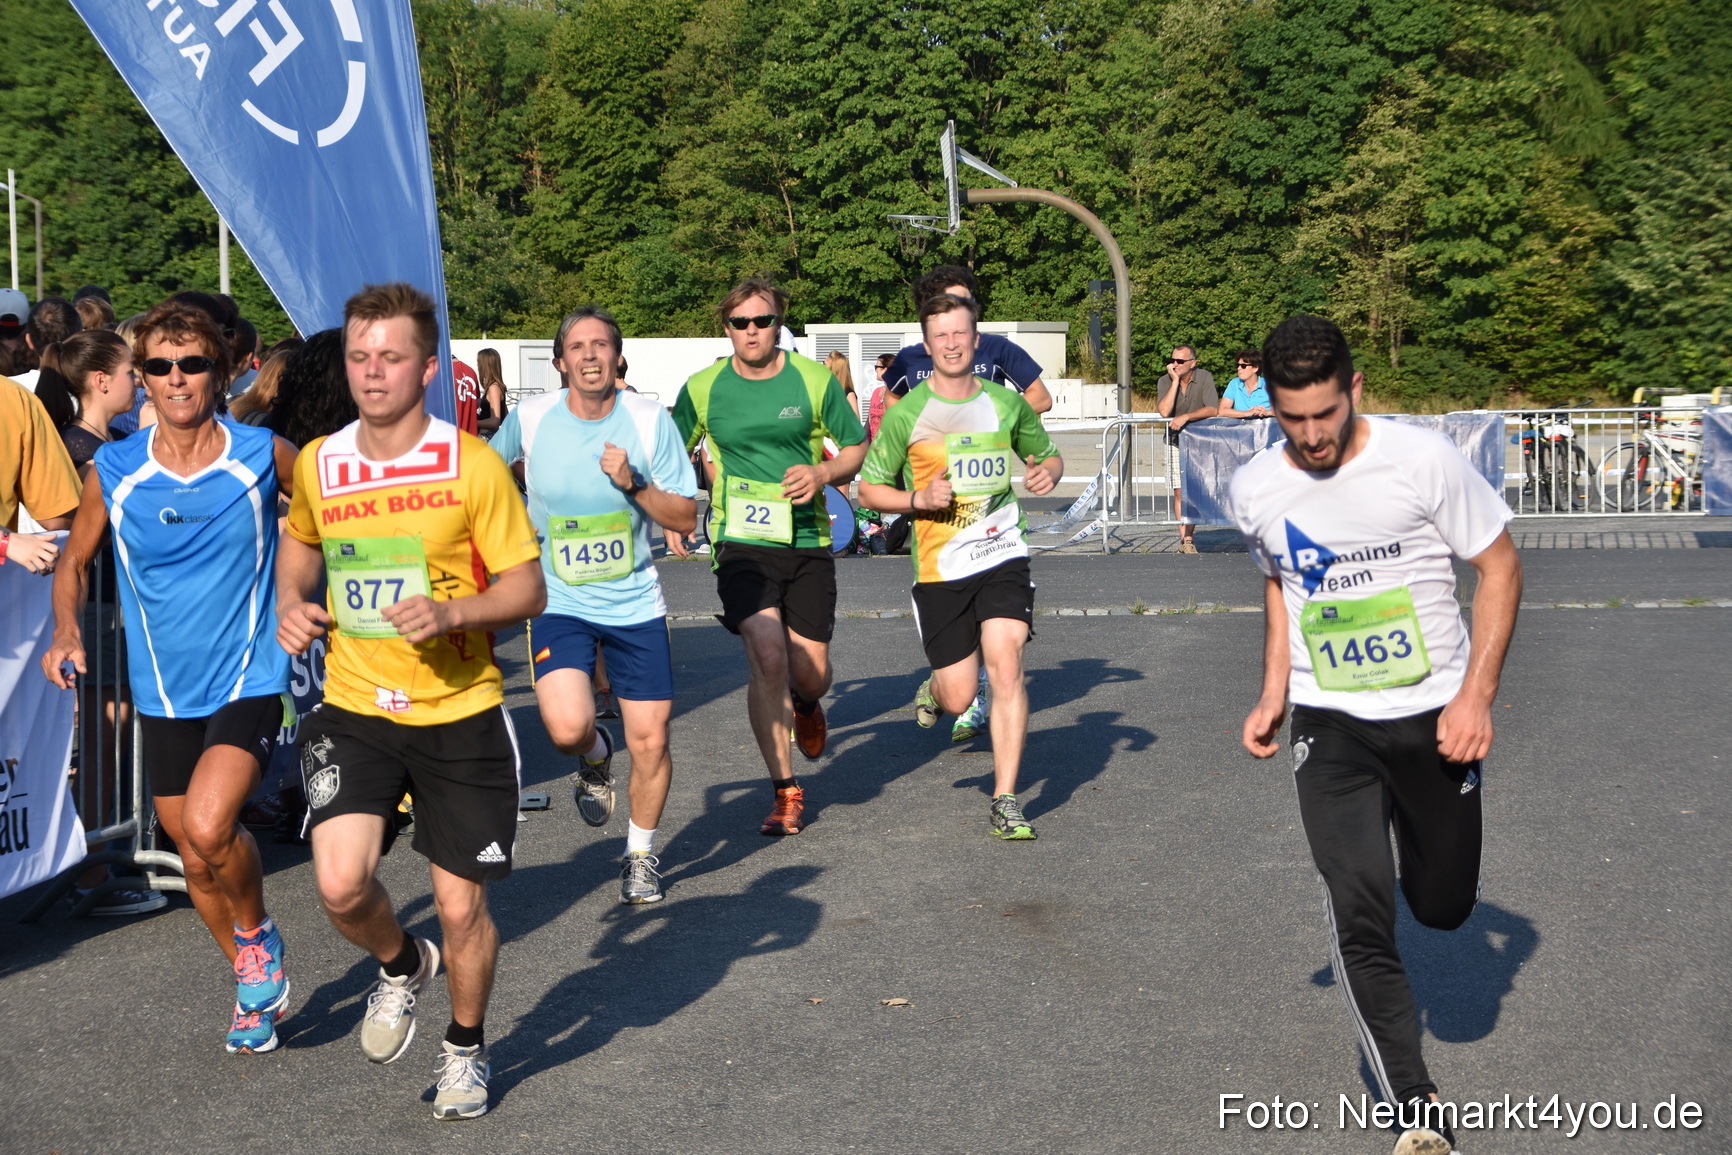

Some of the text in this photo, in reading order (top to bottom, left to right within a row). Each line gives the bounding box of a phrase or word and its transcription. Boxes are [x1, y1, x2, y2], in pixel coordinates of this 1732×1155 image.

[778, 405, 803, 416] AOK
[954, 456, 1006, 478] 1003
[321, 489, 462, 526] MAX BÖGL
[745, 504, 771, 525] 22
[559, 539, 625, 566] 1430
[345, 578, 405, 610] 877
[1318, 629, 1413, 668] 1463
[476, 854, 506, 862] adidas
